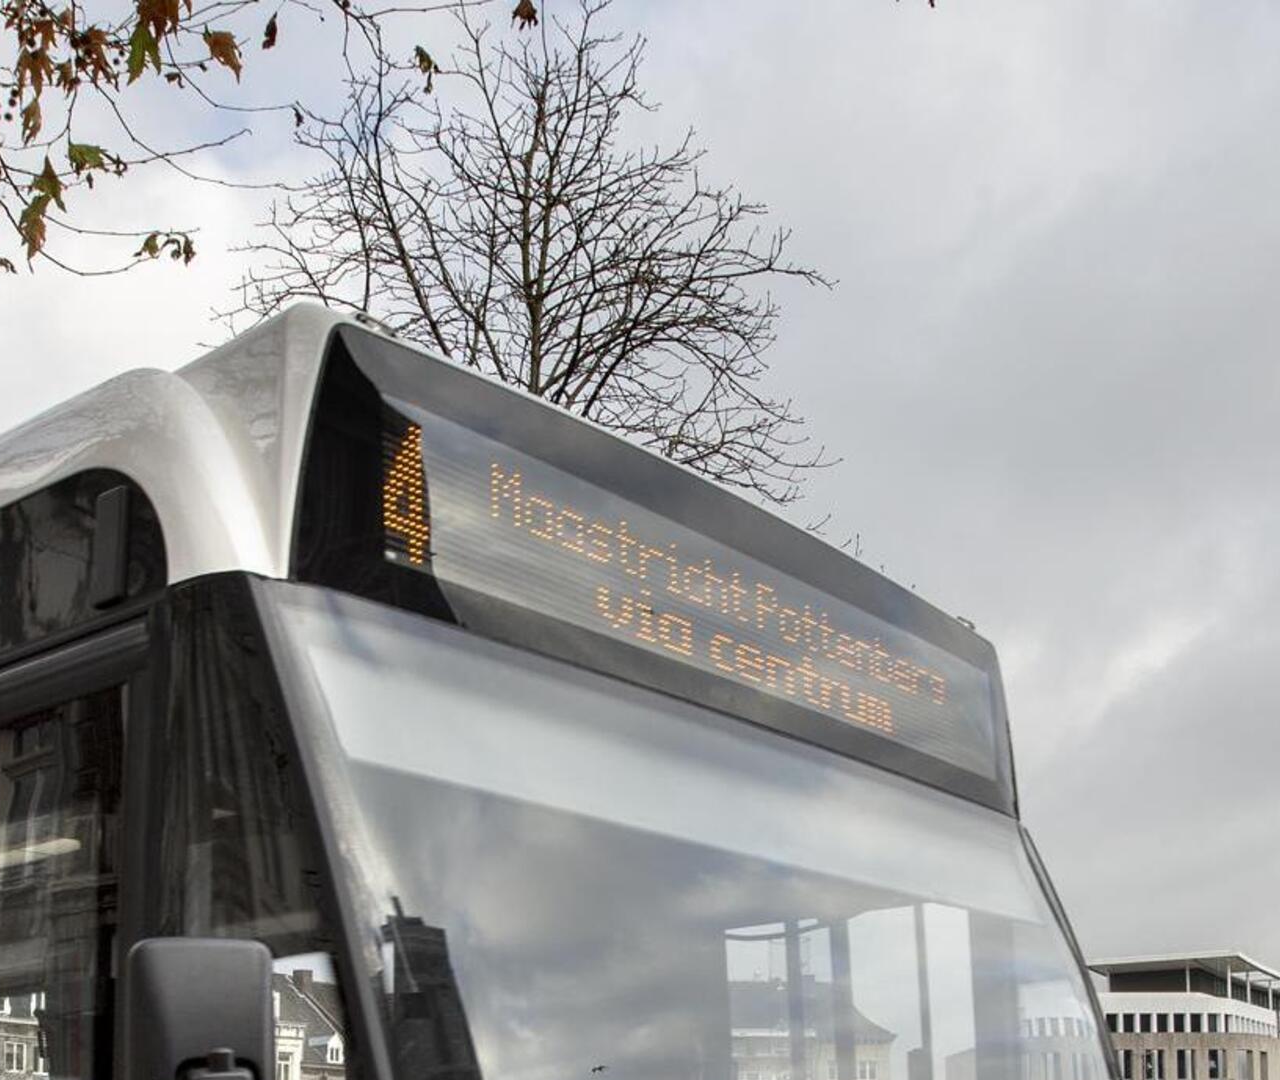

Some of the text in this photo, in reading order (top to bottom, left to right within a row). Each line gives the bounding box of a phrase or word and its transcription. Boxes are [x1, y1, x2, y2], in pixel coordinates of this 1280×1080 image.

[383, 424, 430, 565] 4
[489, 461, 750, 623] Maastricht
[595, 583, 896, 737] via centrum
